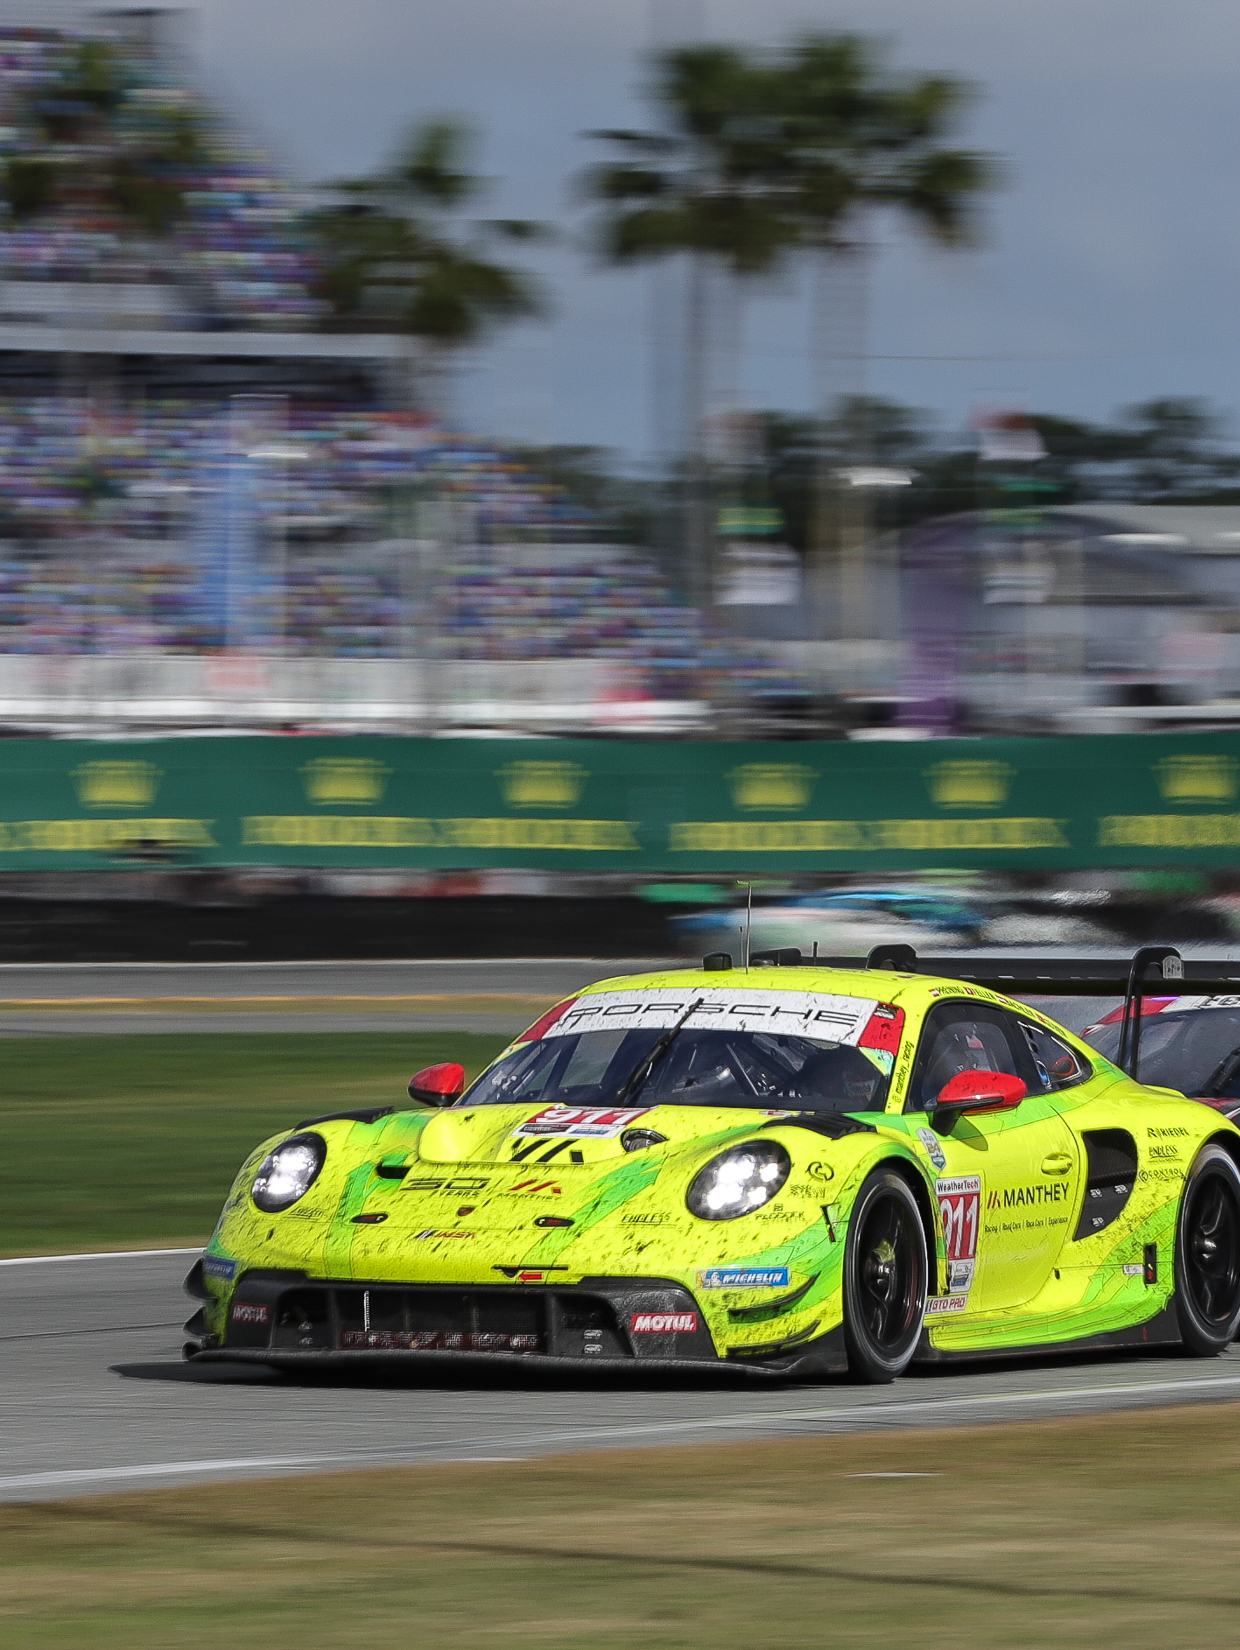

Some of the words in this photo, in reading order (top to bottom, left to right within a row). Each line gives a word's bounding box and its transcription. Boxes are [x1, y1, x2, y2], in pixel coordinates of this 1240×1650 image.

[563, 1002, 861, 1030] PORSCHE
[536, 1108, 646, 1126] 911
[937, 1180, 979, 1193] WeatherTech
[1003, 1182, 1070, 1208] MANTHEY
[621, 1211, 672, 1224] ENDLESS
[940, 1195, 978, 1257] 911
[722, 1270, 784, 1284] MICHELIN
[949, 1296, 966, 1309] PRO
[633, 1313, 695, 1332] MOTUL
